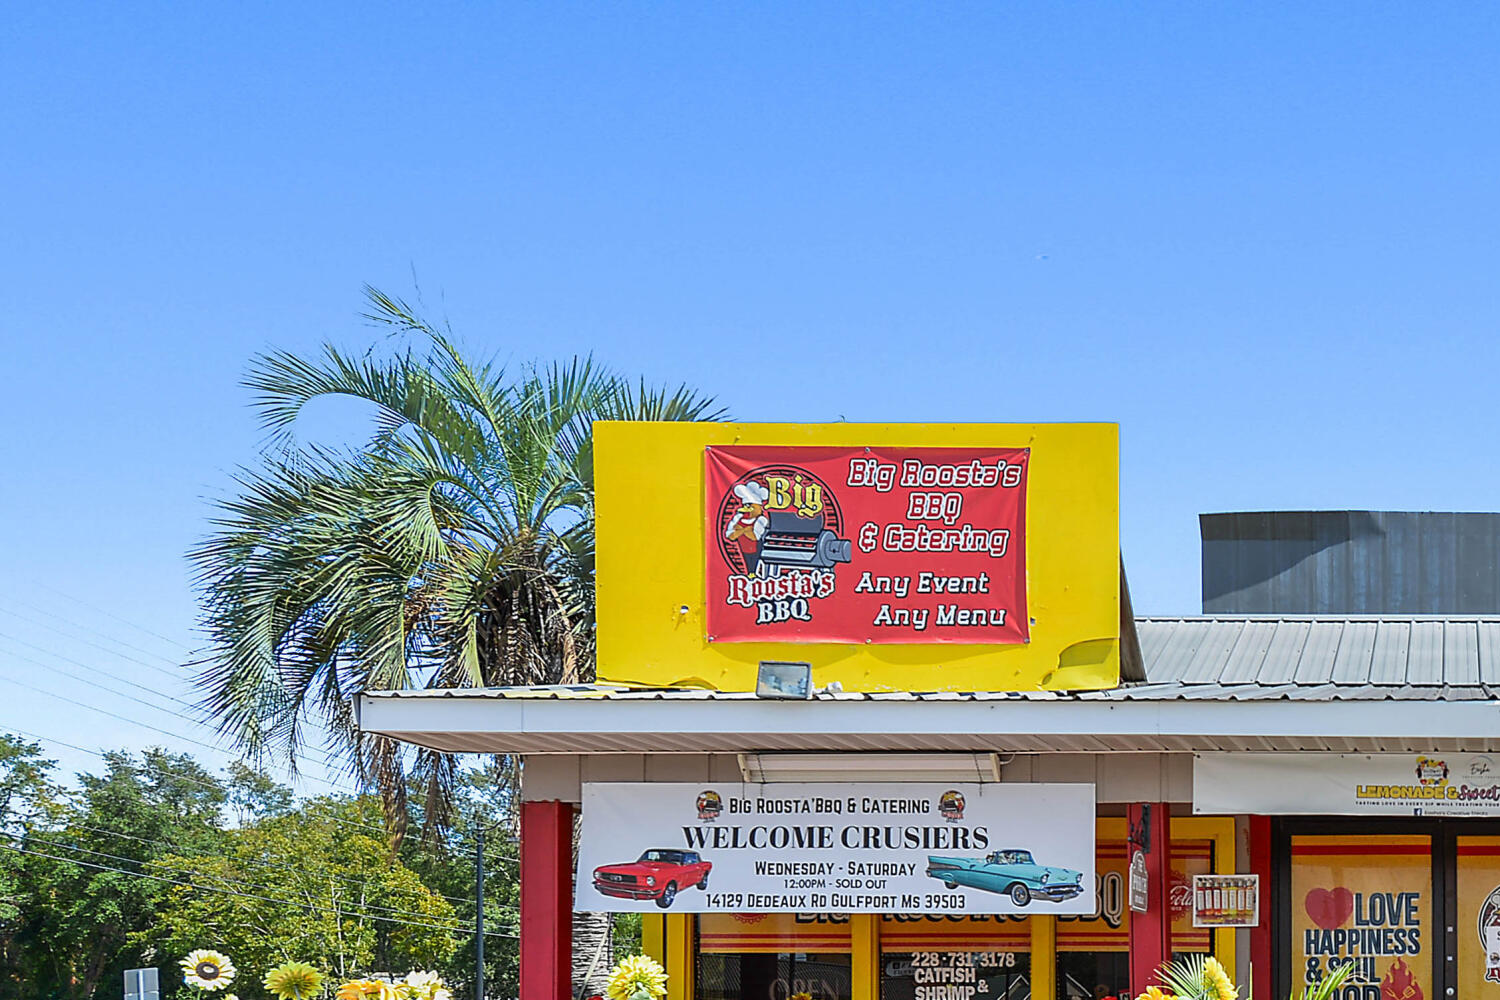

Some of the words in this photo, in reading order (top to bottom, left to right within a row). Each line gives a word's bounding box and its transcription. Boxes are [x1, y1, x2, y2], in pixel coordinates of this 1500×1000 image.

[848, 459, 894, 492] Big
[900, 459, 1022, 489] Roosta's
[765, 474, 823, 517] Big
[907, 492, 962, 525] BBQ
[859, 524, 877, 552] &
[883, 525, 1010, 557] Catering
[727, 569, 836, 606] Roosta's
[855, 572, 910, 597] Any
[917, 572, 990, 594] Event
[757, 601, 811, 624] BBQ
[873, 605, 927, 630] Any
[936, 605, 1006, 626] Menu
[1356, 785, 1445, 799] LEMONADE
[1447, 786, 1459, 799] &
[1459, 785, 1500, 801] Sweet
[730, 798, 751, 814] BIG
[847, 798, 856, 814] &
[862, 798, 930, 814] CATERING
[682, 826, 834, 849] WELCOME
[841, 826, 989, 850] CRUSIERS
[755, 861, 835, 876] WEDNESDAY
[848, 861, 917, 876] SATURDAY
[784, 879, 826, 889] 12:00PM
[836, 879, 863, 889] SOLD
[865, 879, 887, 889] OUT
[706, 894, 742, 908] 14129
[748, 894, 807, 908] DEDEAUX
[831, 894, 899, 909] GULFPORT
[925, 894, 966, 909] 39503
[1353, 892, 1421, 928] LOVE
[1304, 928, 1421, 957] HAPPINESS
[914, 968, 976, 983] CATFISH
[1305, 956, 1324, 984] &
[977, 979, 989, 993] &
